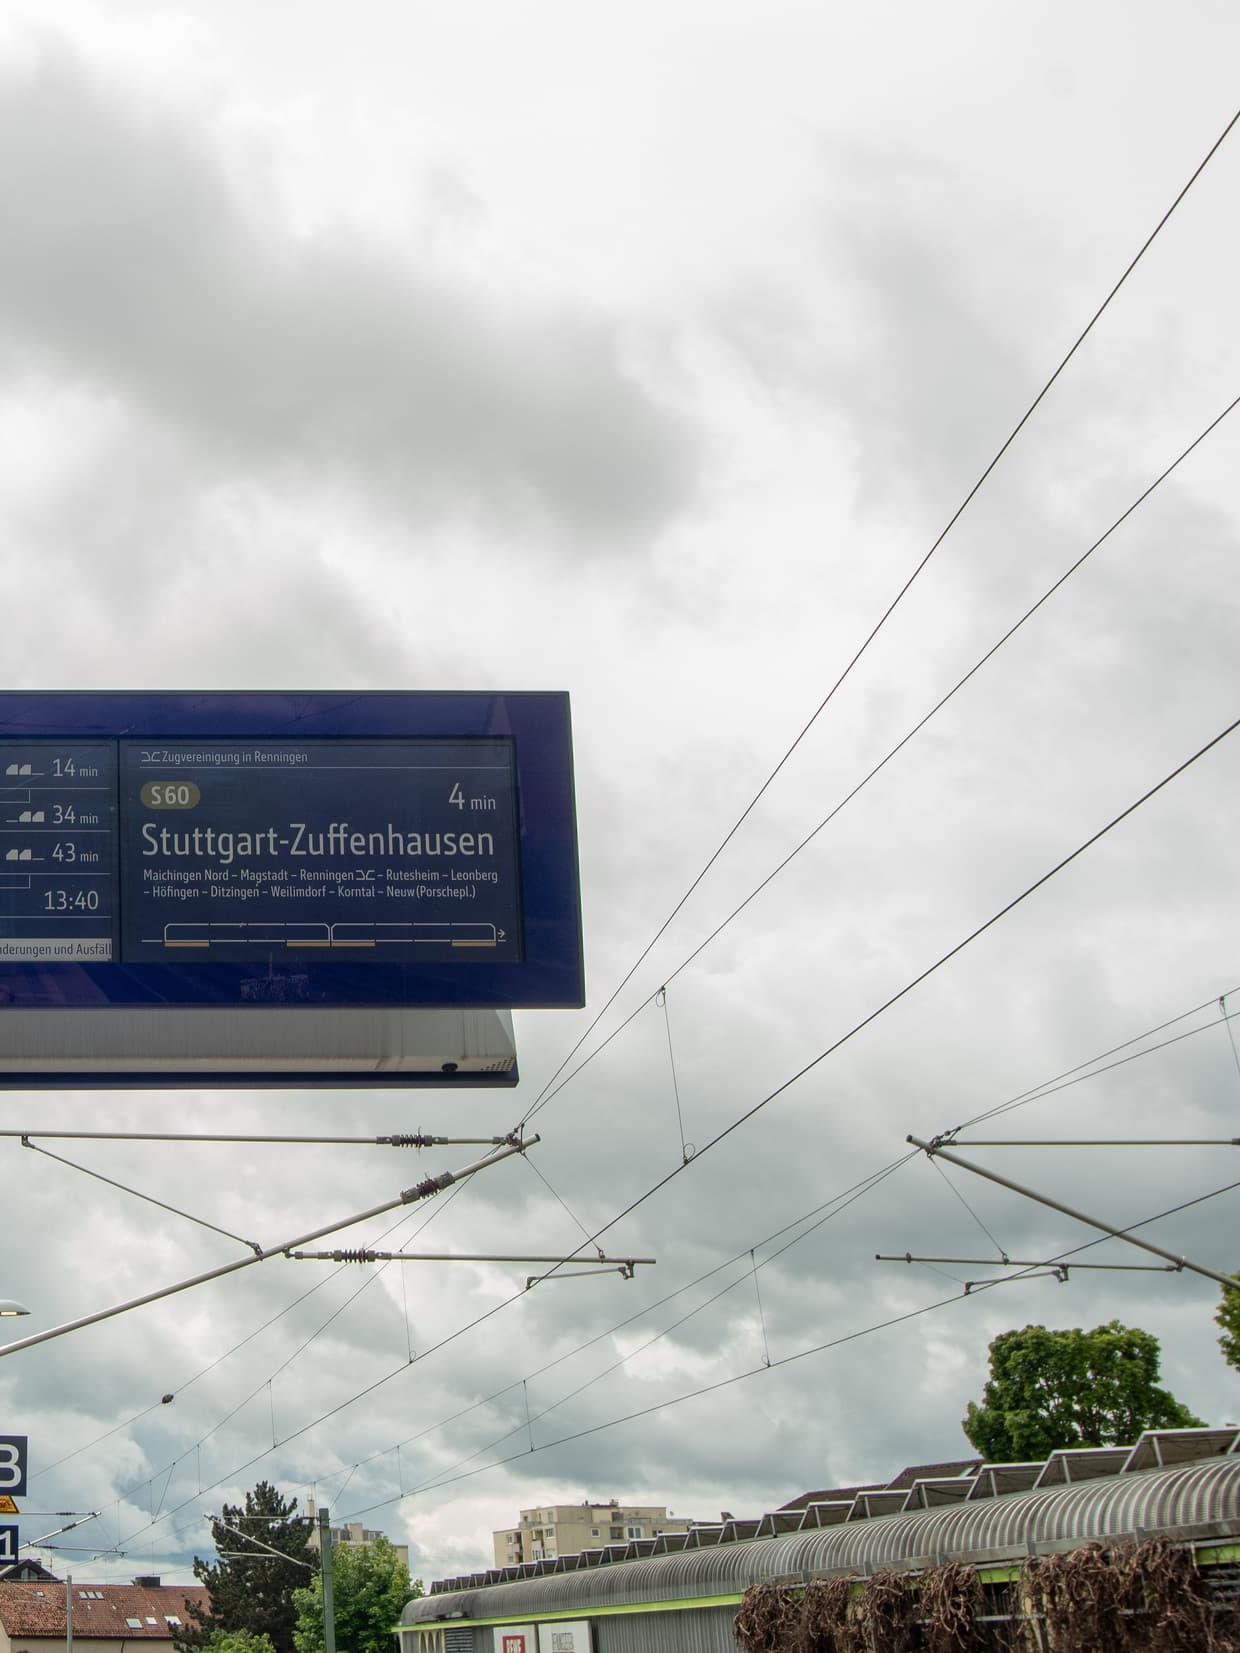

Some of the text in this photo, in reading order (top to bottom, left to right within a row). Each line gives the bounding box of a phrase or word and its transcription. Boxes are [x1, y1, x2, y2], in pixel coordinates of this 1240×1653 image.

[52, 758, 76, 777] 14
[79, 766, 98, 777] min
[162, 751, 308, 765] Zugvereinigung in Renningen
[448, 782, 466, 810] 4
[470, 794, 497, 811] min
[52, 805, 76, 824] 34
[79, 813, 98, 824] min
[52, 842, 76, 862] 43
[80, 850, 99, 862] min
[142, 822, 494, 864] Stuttgart-Zuffenhausen
[143, 869, 202, 884] Maichingen
[204, 869, 229, 881] Nord
[240, 869, 289, 885] Magstadt
[300, 869, 354, 884] Renningen
[386, 869, 440, 881] Rutesheim
[451, 869, 498, 884] Leonberg
[44, 890, 99, 910] 13:40
[152, 885, 199, 901] Höfingen
[210, 886, 259, 901] Ditzingen
[271, 885, 326, 897] Weilimdorf
[338, 885, 375, 897] Korntal
[54, 943, 73, 955] und
[0, 1530, 15, 1560] 1
